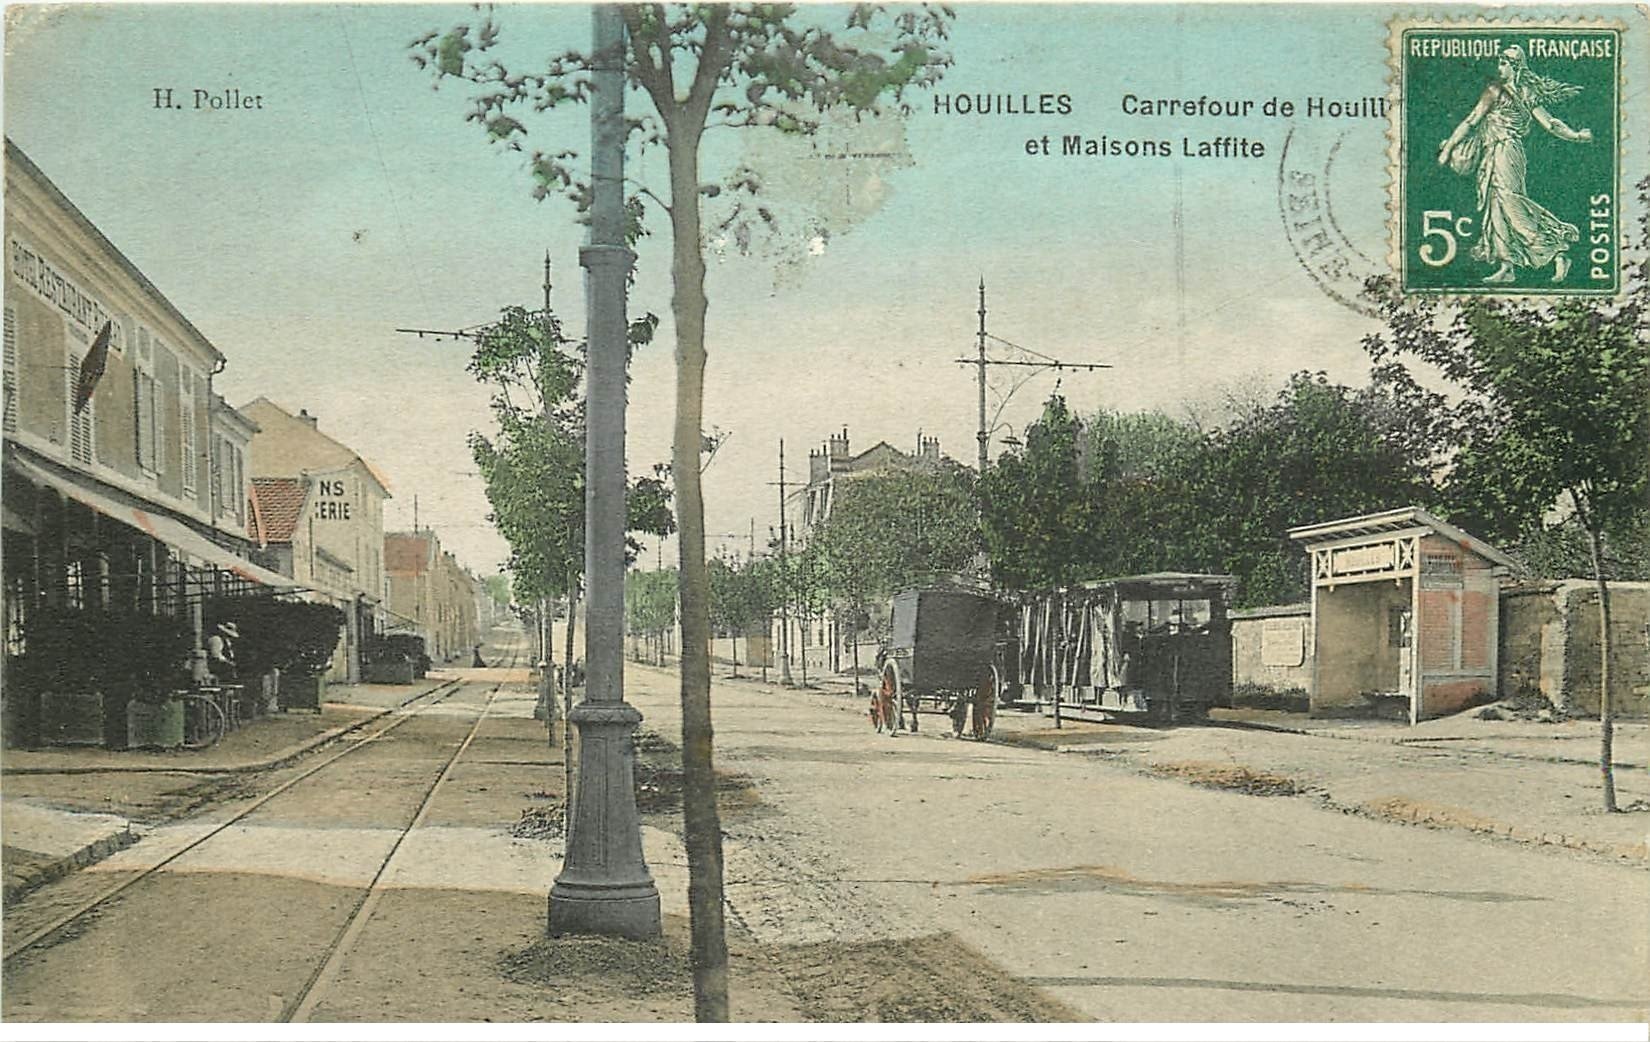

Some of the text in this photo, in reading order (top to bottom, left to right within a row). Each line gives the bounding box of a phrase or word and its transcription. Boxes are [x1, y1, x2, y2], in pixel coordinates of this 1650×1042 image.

[1529, 38, 1611, 60] FRANÇAISE
[1590, 193, 1610, 280] POSTES
[314, 501, 350, 520] ERIE
